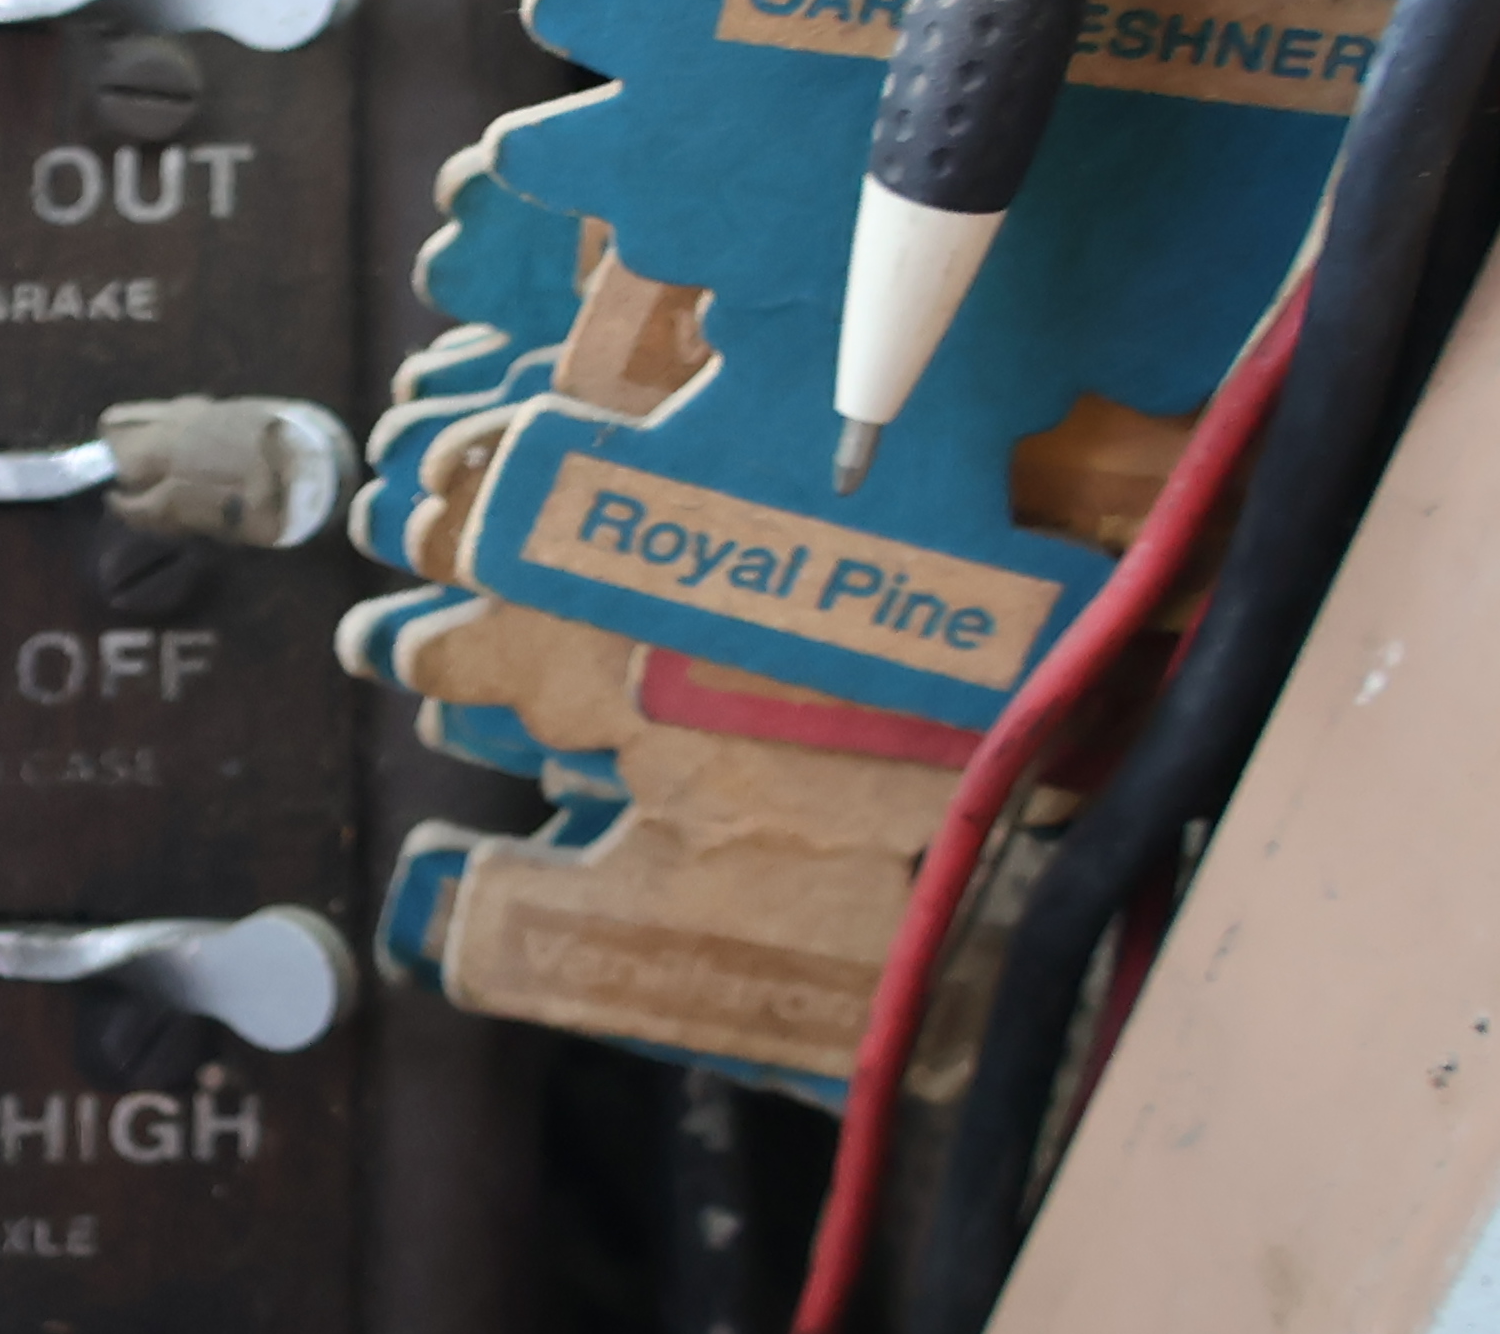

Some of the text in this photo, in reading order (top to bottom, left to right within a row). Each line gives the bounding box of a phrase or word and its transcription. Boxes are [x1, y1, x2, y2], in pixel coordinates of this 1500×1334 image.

[1077, 6, 1376, 85] ESHNER
[32, 147, 254, 223] OUT
[578, 489, 997, 651] Royal Pine
[18, 630, 217, 704] OFF
[0, 1091, 262, 1163] HIGH
